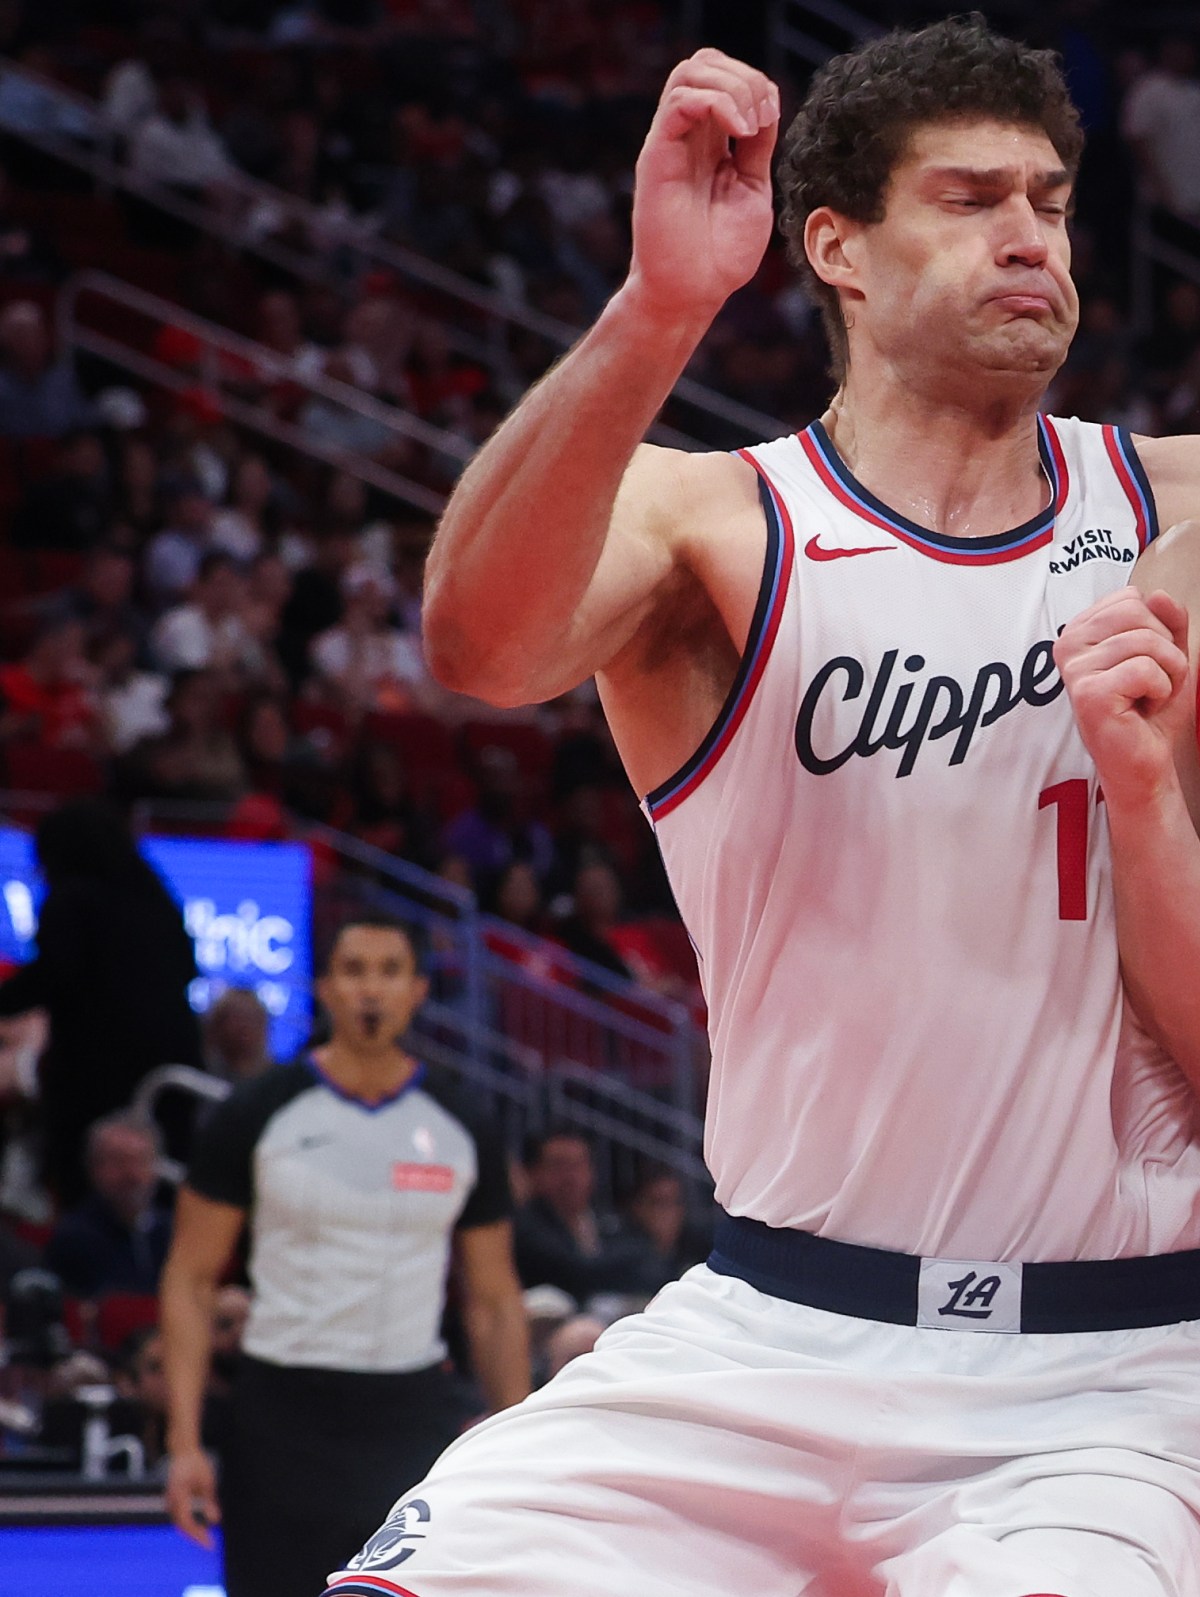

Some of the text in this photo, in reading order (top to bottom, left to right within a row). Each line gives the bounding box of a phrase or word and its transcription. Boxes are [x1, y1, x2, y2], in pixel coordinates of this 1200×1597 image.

[1049, 545, 1134, 574] RWANDA
[1062, 529, 1112, 554] VISIT
[795, 623, 1067, 778] Clippe
[1038, 779, 1105, 920] 1
[938, 1271, 1002, 1320] LA
